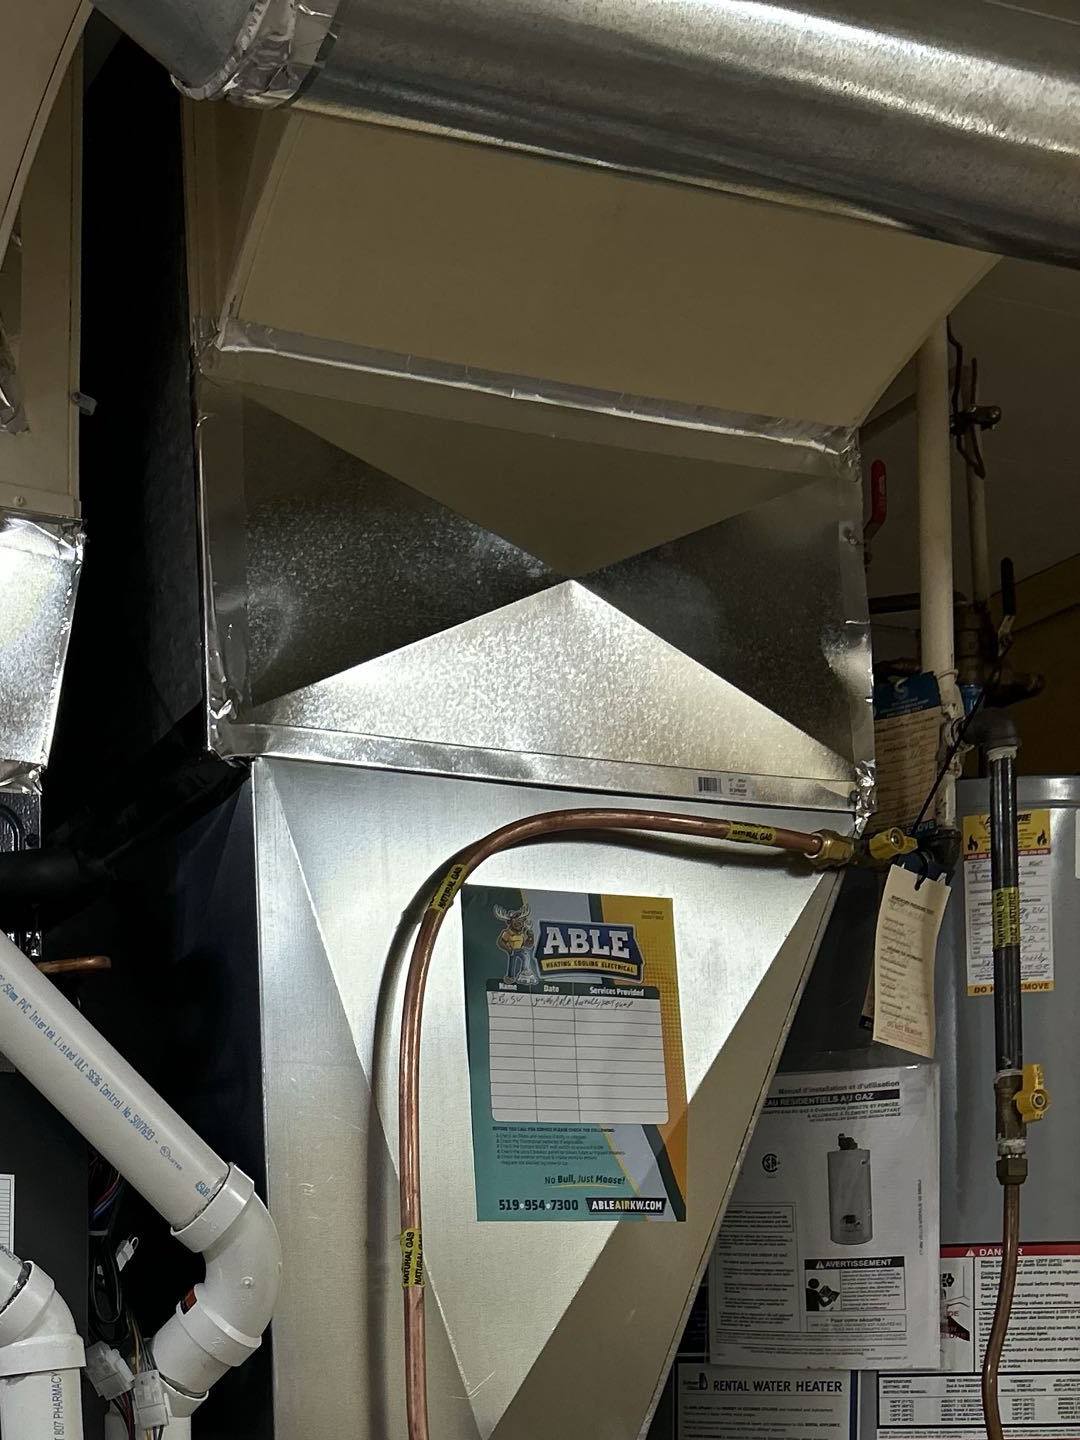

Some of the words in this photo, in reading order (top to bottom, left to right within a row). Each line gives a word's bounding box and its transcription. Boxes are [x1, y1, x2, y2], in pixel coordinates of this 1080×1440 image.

[543, 926, 630, 959] ABLE
[601, 962, 634, 972] ELECTRICAL
[544, 985, 559, 993] Date
[589, 986, 616, 994] Services
[617, 988, 645, 997] Provided
[974, 986, 987, 994] DO
[17, 998, 32, 1014] PVC
[29, 1011, 55, 1040] Intertek
[55, 1037, 77, 1060] Listed
[74, 1057, 89, 1073] ULC
[99, 1083, 125, 1110] Control
[858, 1081, 900, 1089] d'utilisation
[855, 1093, 874, 1101] GAZ
[545, 1176, 556, 1185] No
[558, 1175, 576, 1185] Bull,
[577, 1175, 594, 1184] Just
[595, 1175, 626, 1185] Moose!
[591, 1200, 662, 1211] ABLEAIRKW.COM
[825, 1259, 893, 1268] AVERTISSEMENT
[713, 1380, 749, 1392] RENTAL
[753, 1380, 791, 1392] WATER
[796, 1381, 842, 1393] HEATER
[51, 1371, 64, 1419] PHARMACY
[54, 1421, 65, 1435] 807
